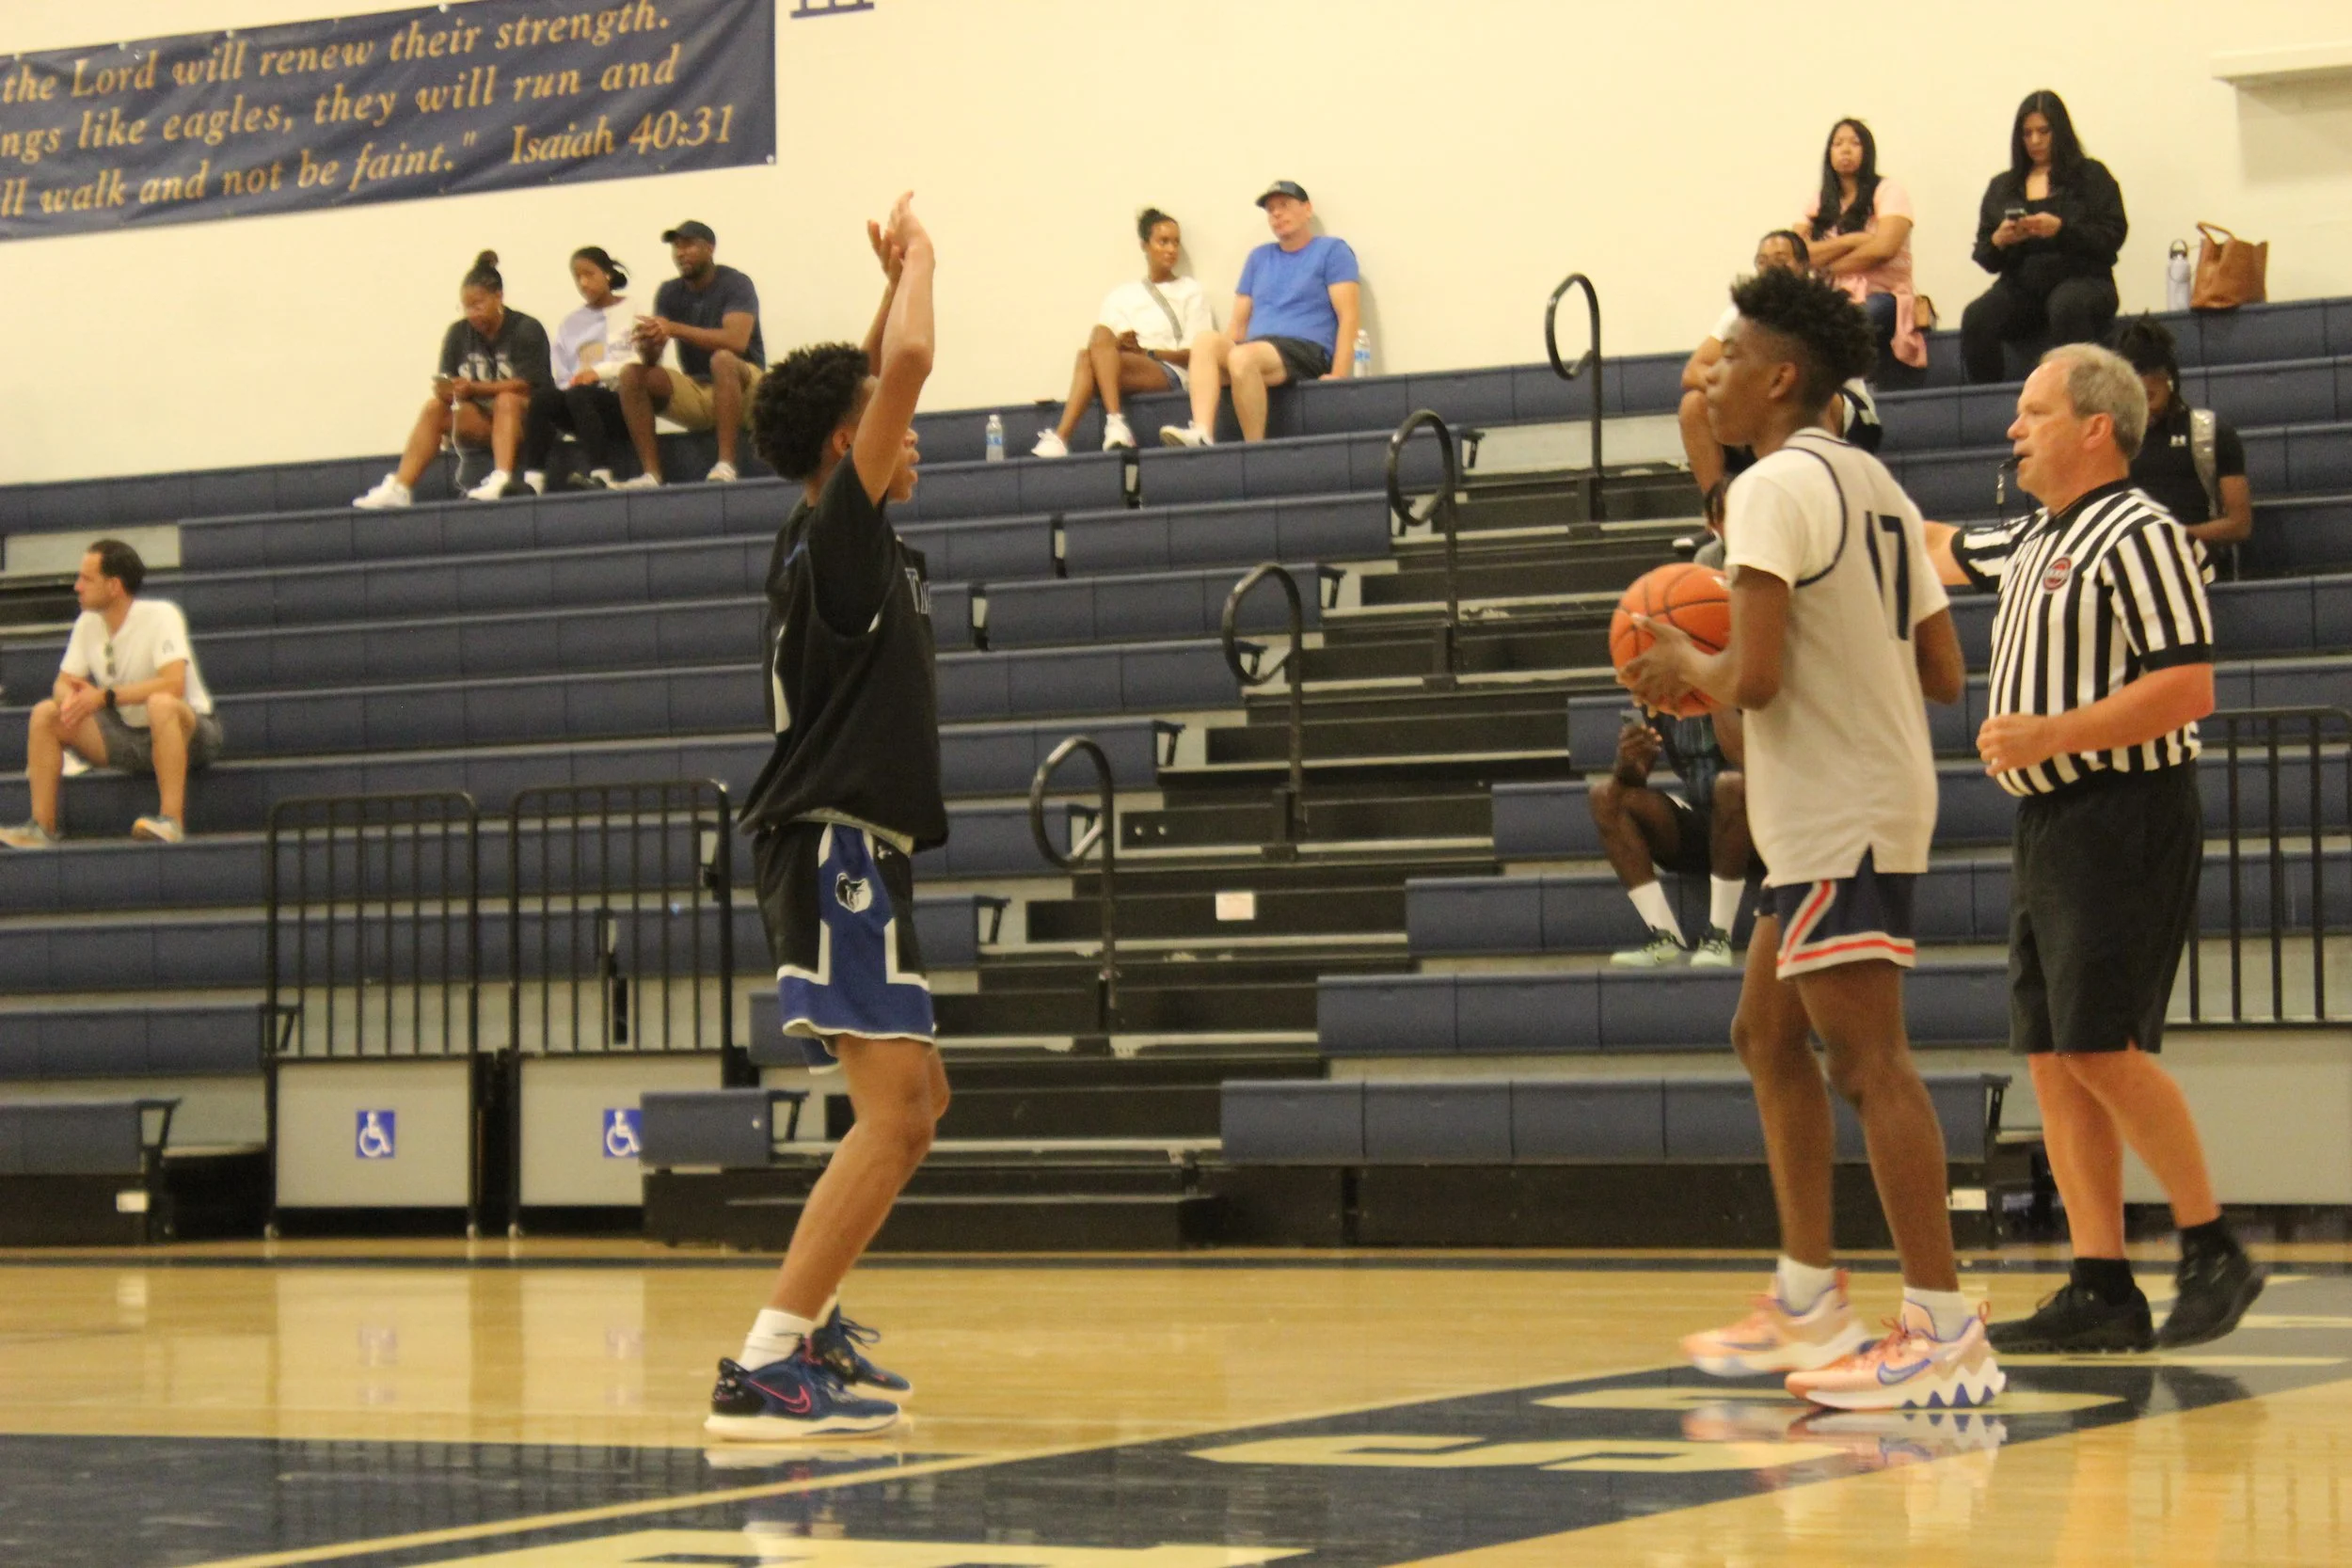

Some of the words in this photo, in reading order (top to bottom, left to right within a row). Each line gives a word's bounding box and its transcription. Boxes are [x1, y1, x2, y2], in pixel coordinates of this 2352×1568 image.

[0, 127, 61, 165] ngs
[78, 108, 147, 148] like
[164, 95, 293, 144] eagles,
[315, 84, 396, 124] they
[418, 67, 497, 112] will
[515, 70, 580, 101] run
[601, 42, 681, 90] and
[3, 64, 56, 103] the
[71, 50, 158, 98] Lord
[173, 40, 246, 84] will
[261, 42, 374, 74] renew
[390, 20, 481, 60] their
[495, 0, 669, 47] strength.
[39, 169, 126, 214] walk
[139, 160, 209, 203] and
[224, 164, 280, 194] not
[297, 150, 339, 187] be
[512, 117, 613, 164] Isaiah
[629, 105, 733, 154] 40:31
